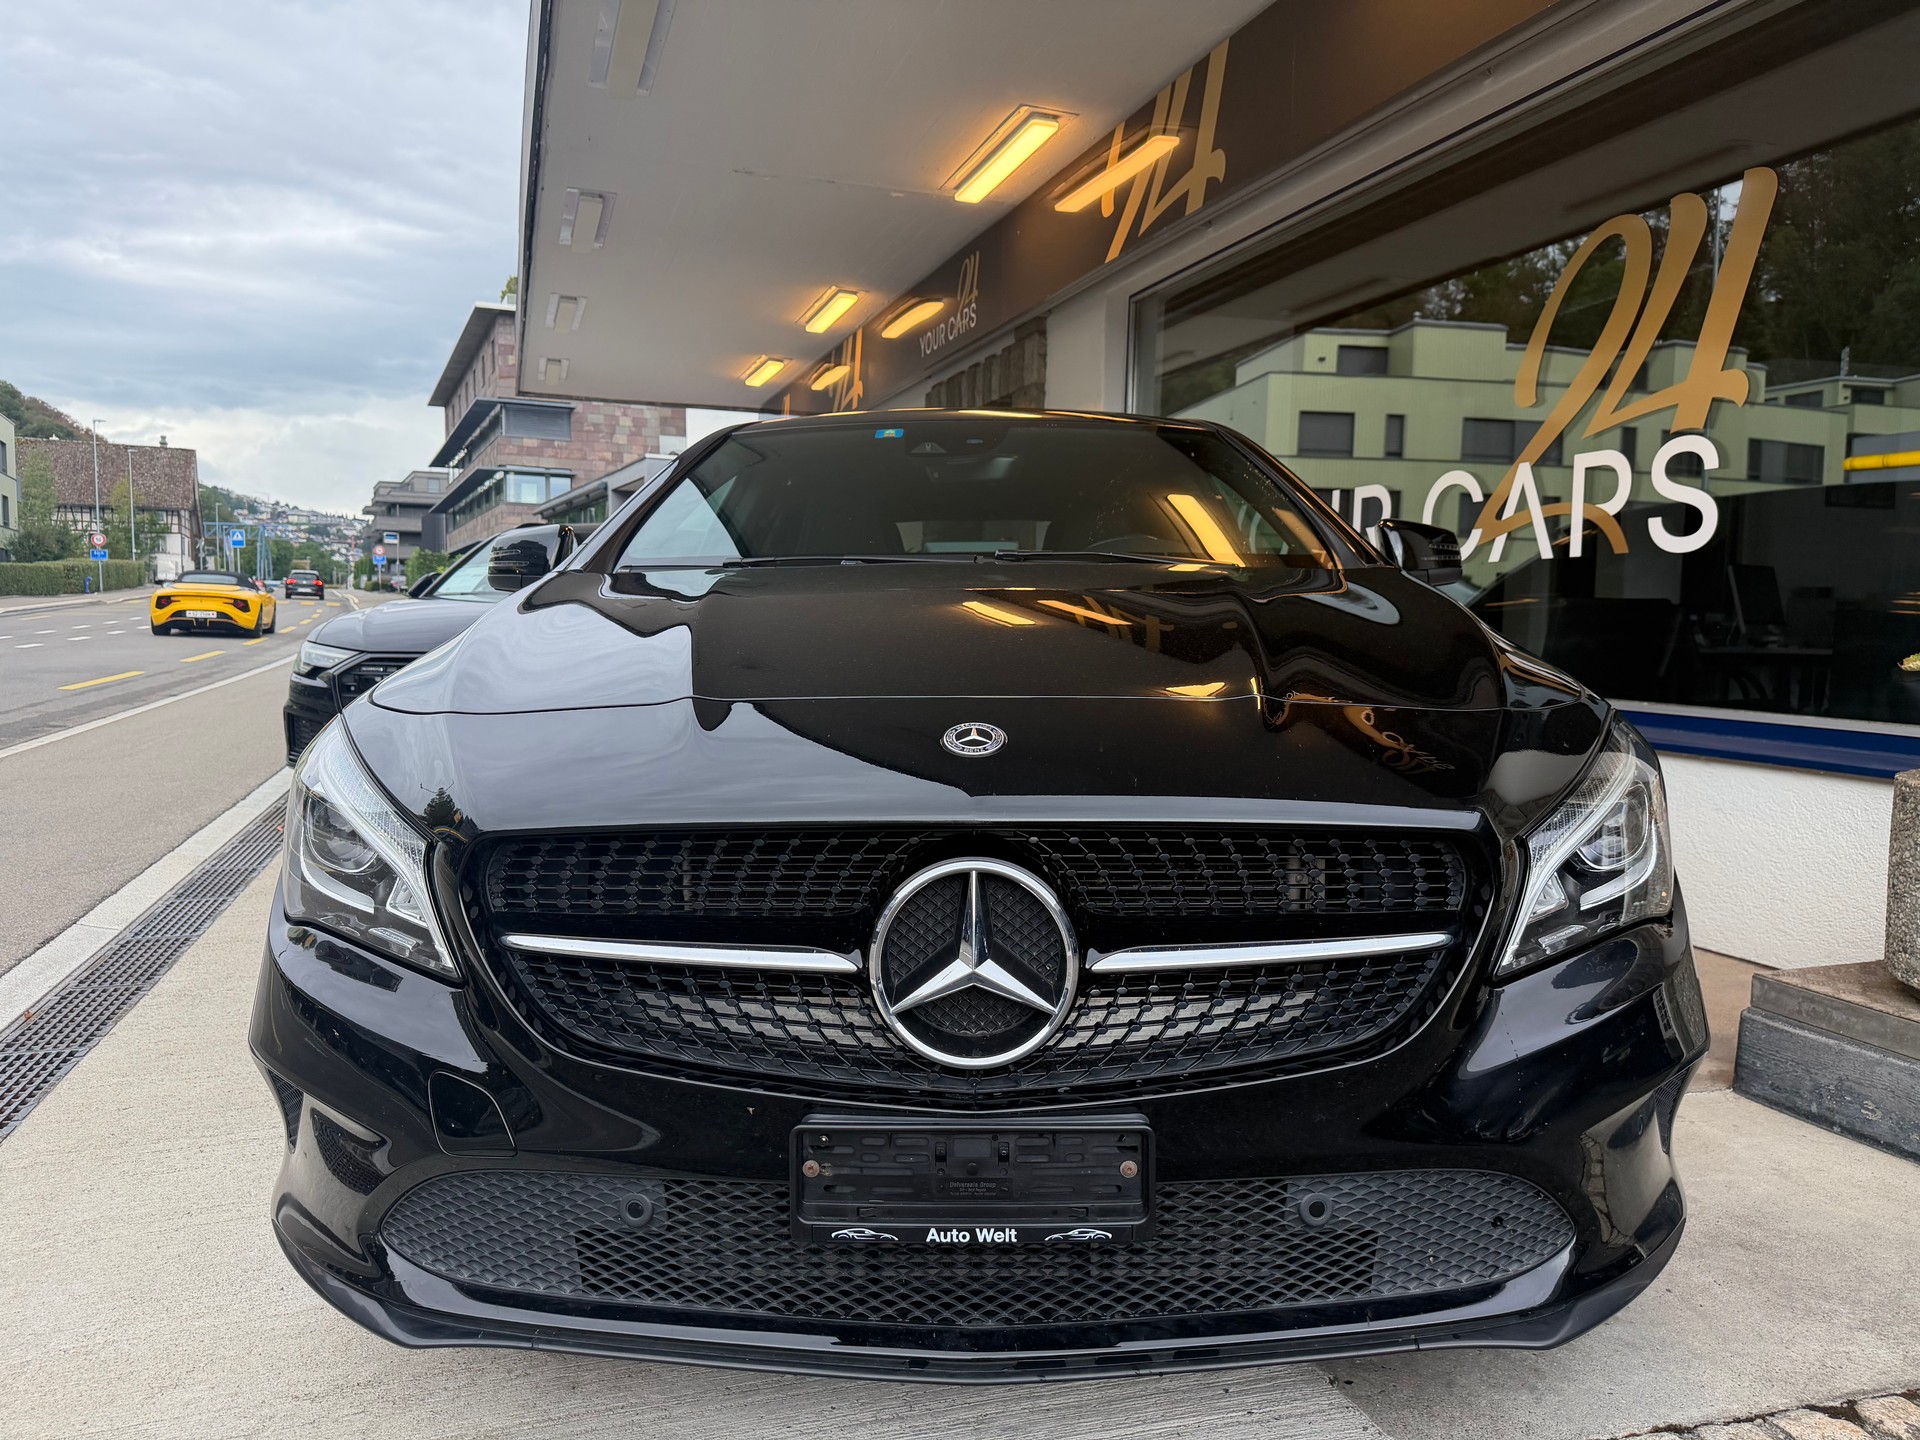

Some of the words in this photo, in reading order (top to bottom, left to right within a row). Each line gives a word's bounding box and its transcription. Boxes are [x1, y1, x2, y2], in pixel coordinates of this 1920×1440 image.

[919, 323, 946, 358] YOUR
[947, 302, 977, 340] CARS
[1477, 167, 1778, 554] 24
[1422, 434, 1719, 563] CARS
[926, 1227, 971, 1243] Auto
[975, 1227, 1018, 1243] Welt
